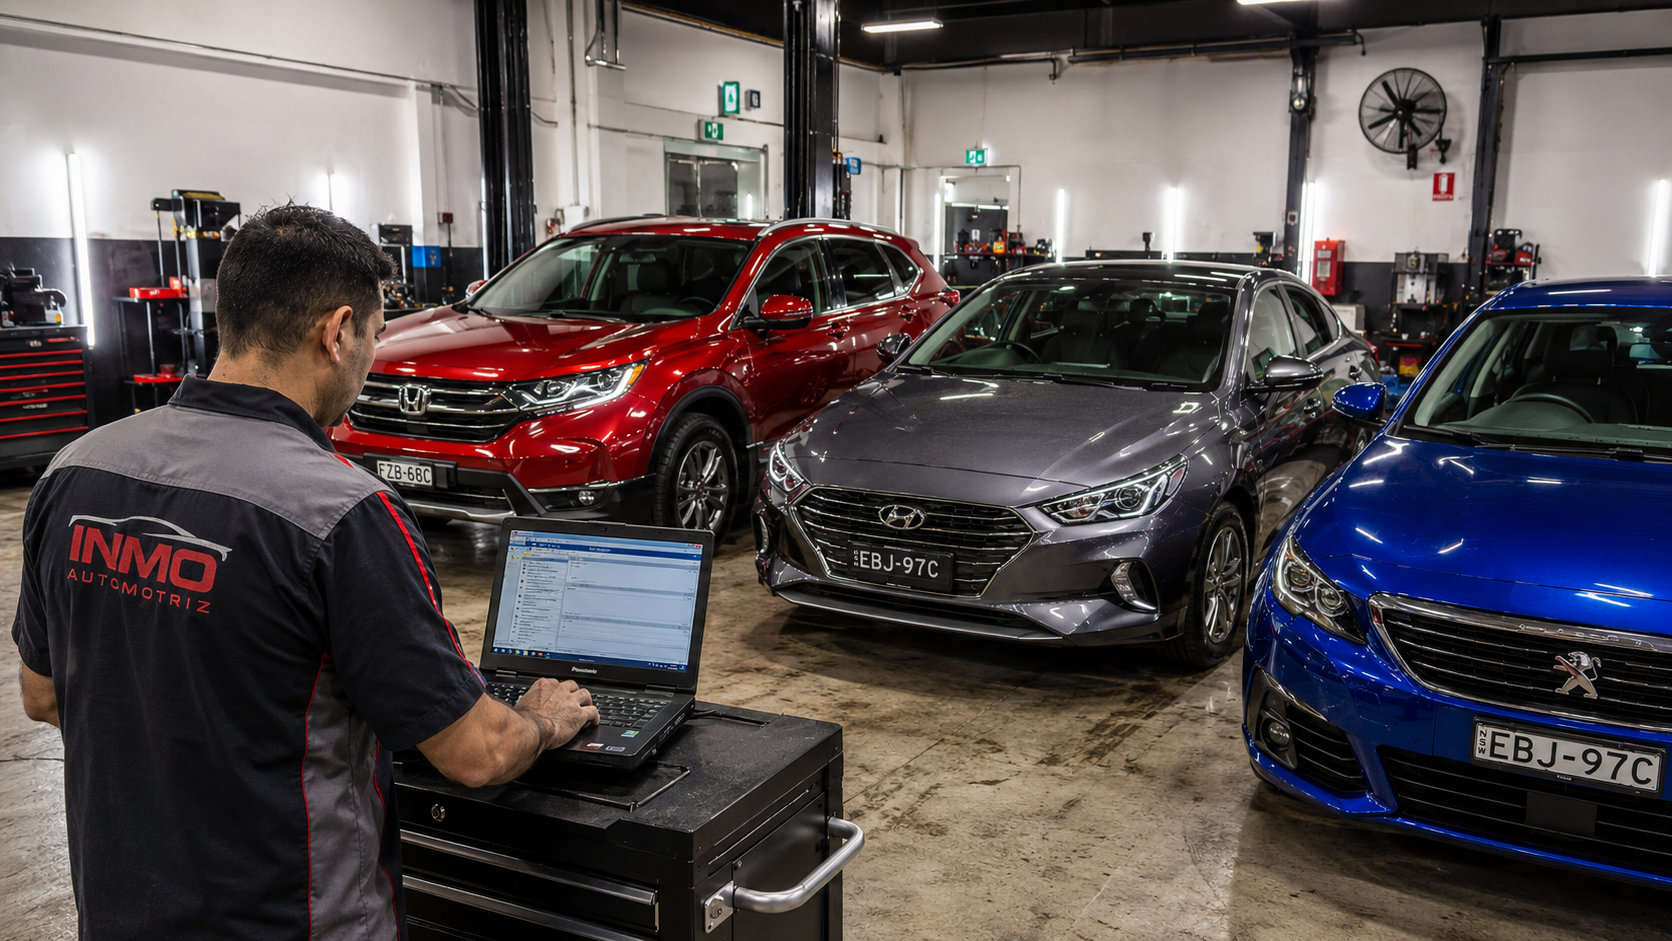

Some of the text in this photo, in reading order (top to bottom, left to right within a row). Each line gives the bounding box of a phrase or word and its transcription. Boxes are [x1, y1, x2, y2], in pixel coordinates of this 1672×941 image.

[69, 524, 218, 593] INMO
[860, 550, 939, 578] EBJ-97C
[67, 568, 211, 614] AUTOMOTRIZ
[1477, 729, 1487, 755] NSW
[1489, 731, 1654, 785] EBJ-97C
